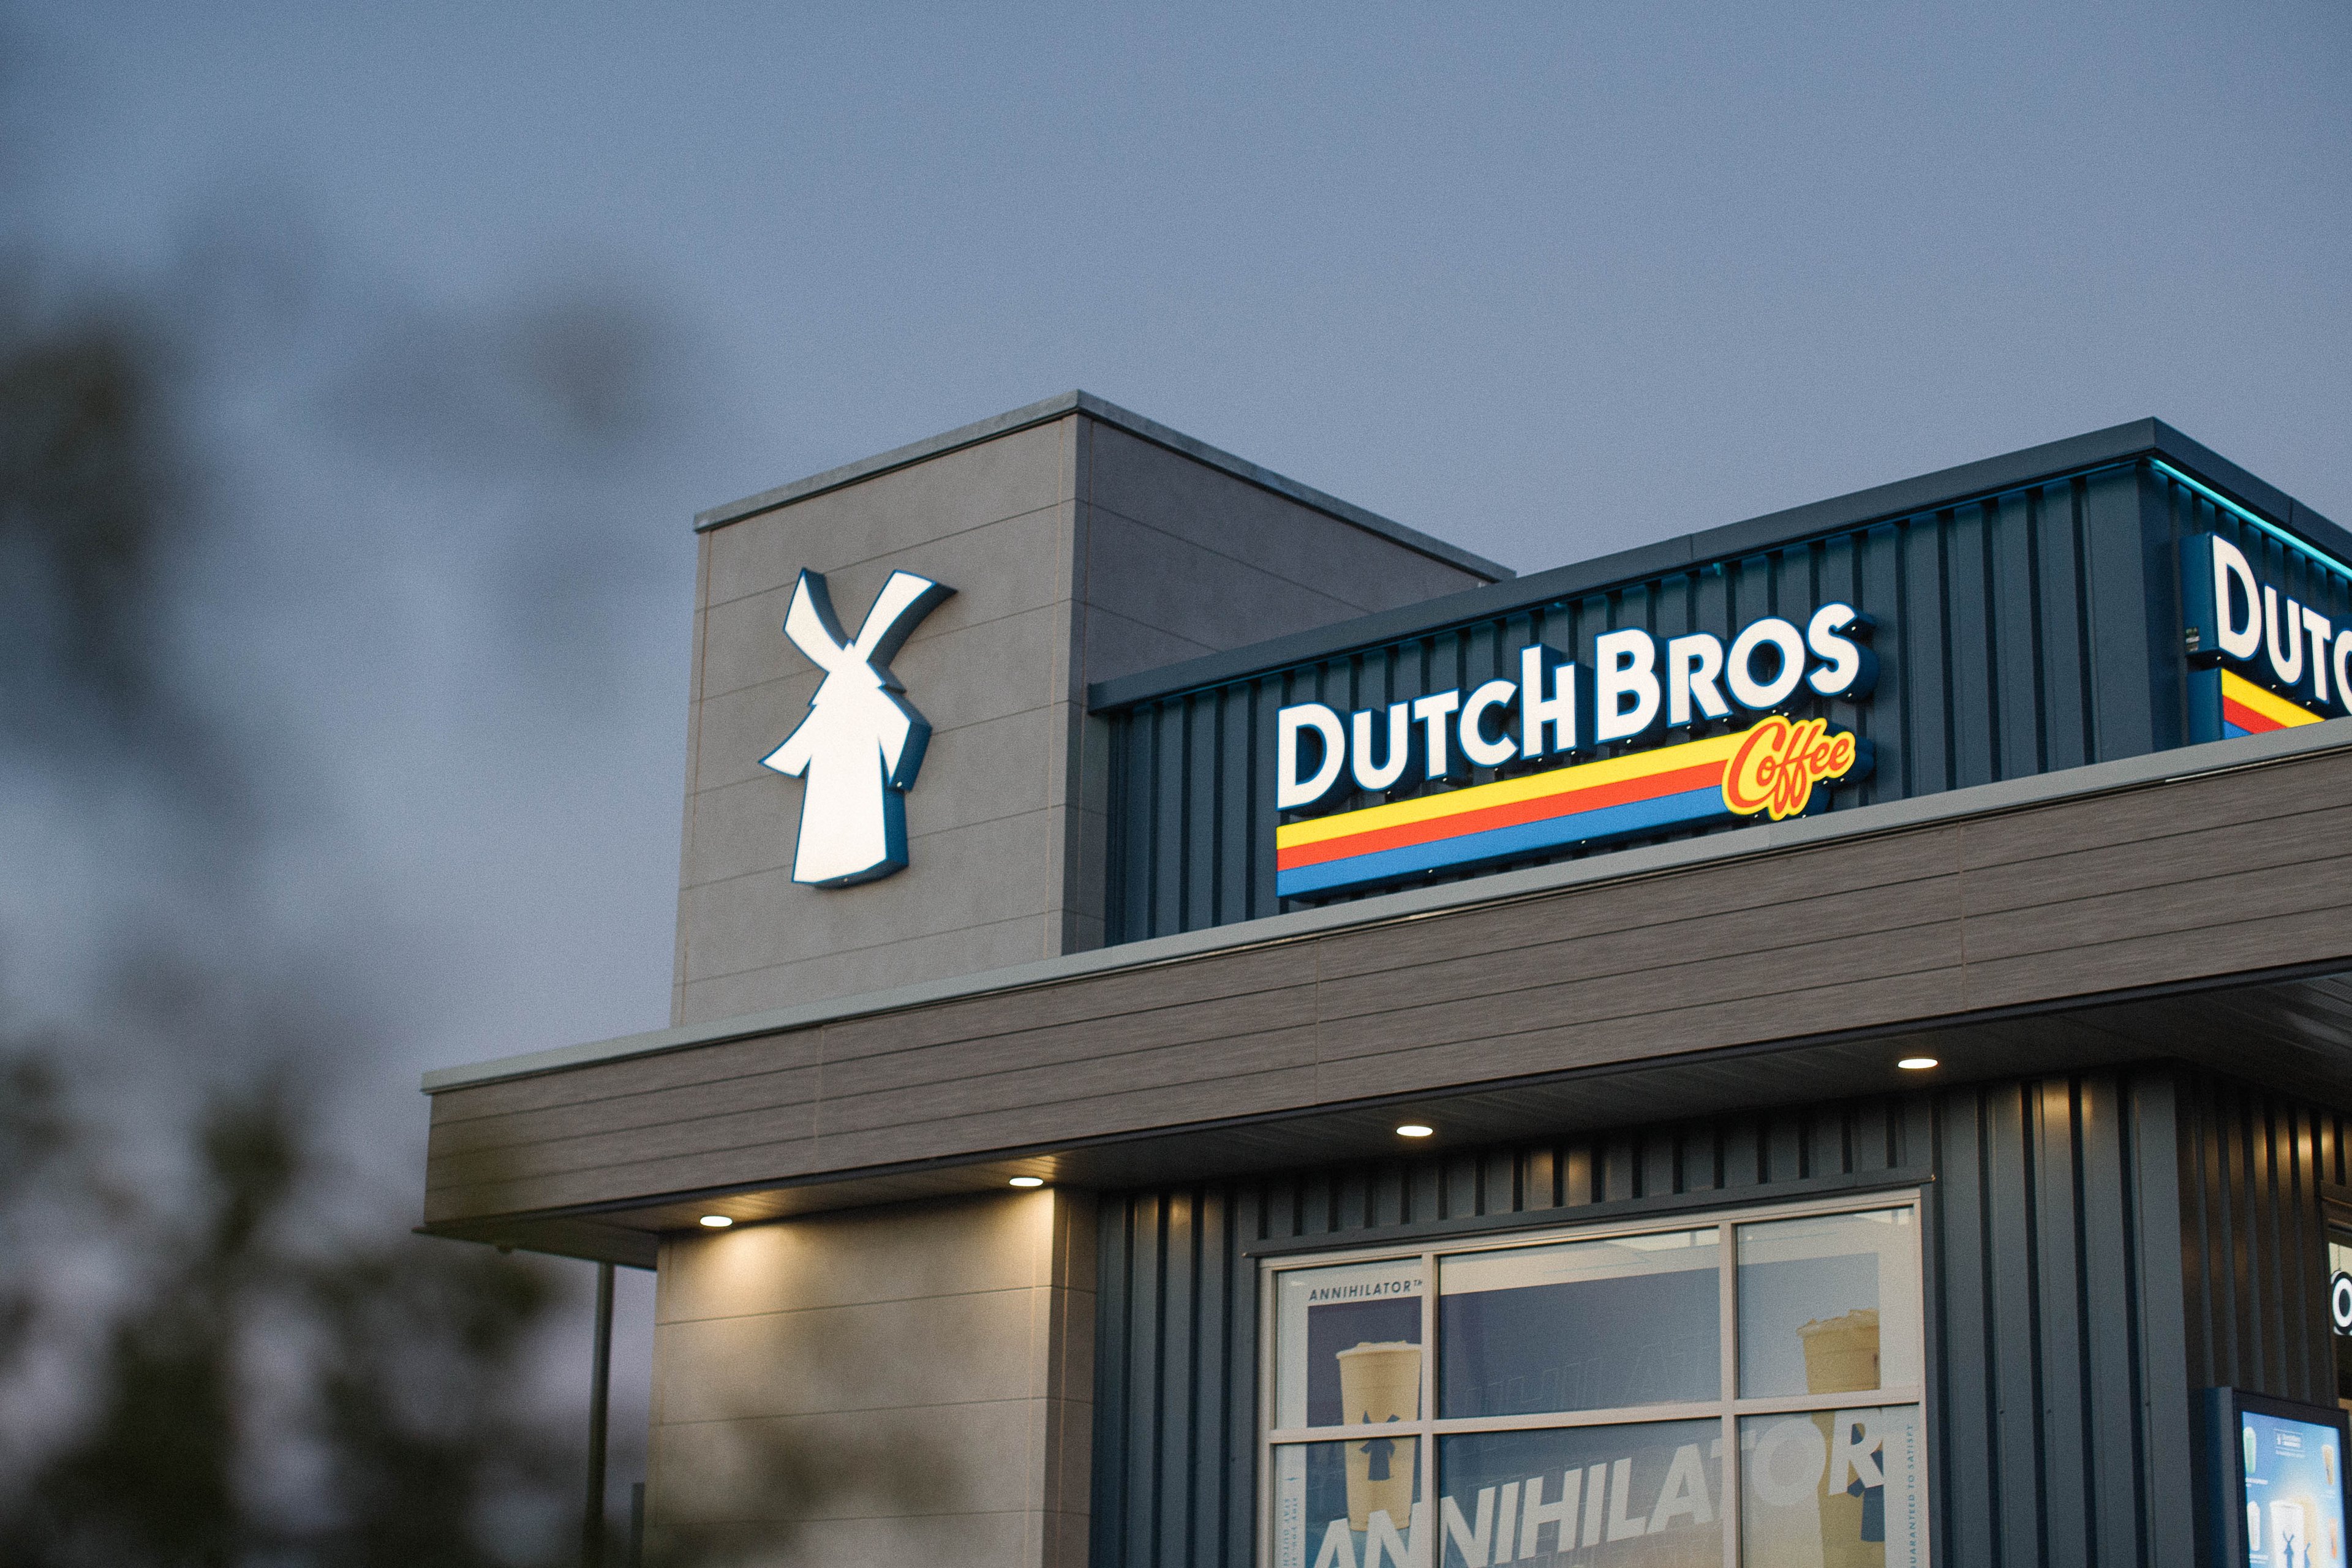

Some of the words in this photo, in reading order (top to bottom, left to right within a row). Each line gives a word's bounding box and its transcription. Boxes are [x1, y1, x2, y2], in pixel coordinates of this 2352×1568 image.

[1278, 644, 1575, 810] DUTCH
[1595, 601, 1861, 743] BROS
[1727, 722, 1851, 815] Coffee
[1905, 1425, 1915, 1469] SATISFY
[1907, 1475, 1915, 1489] TO
